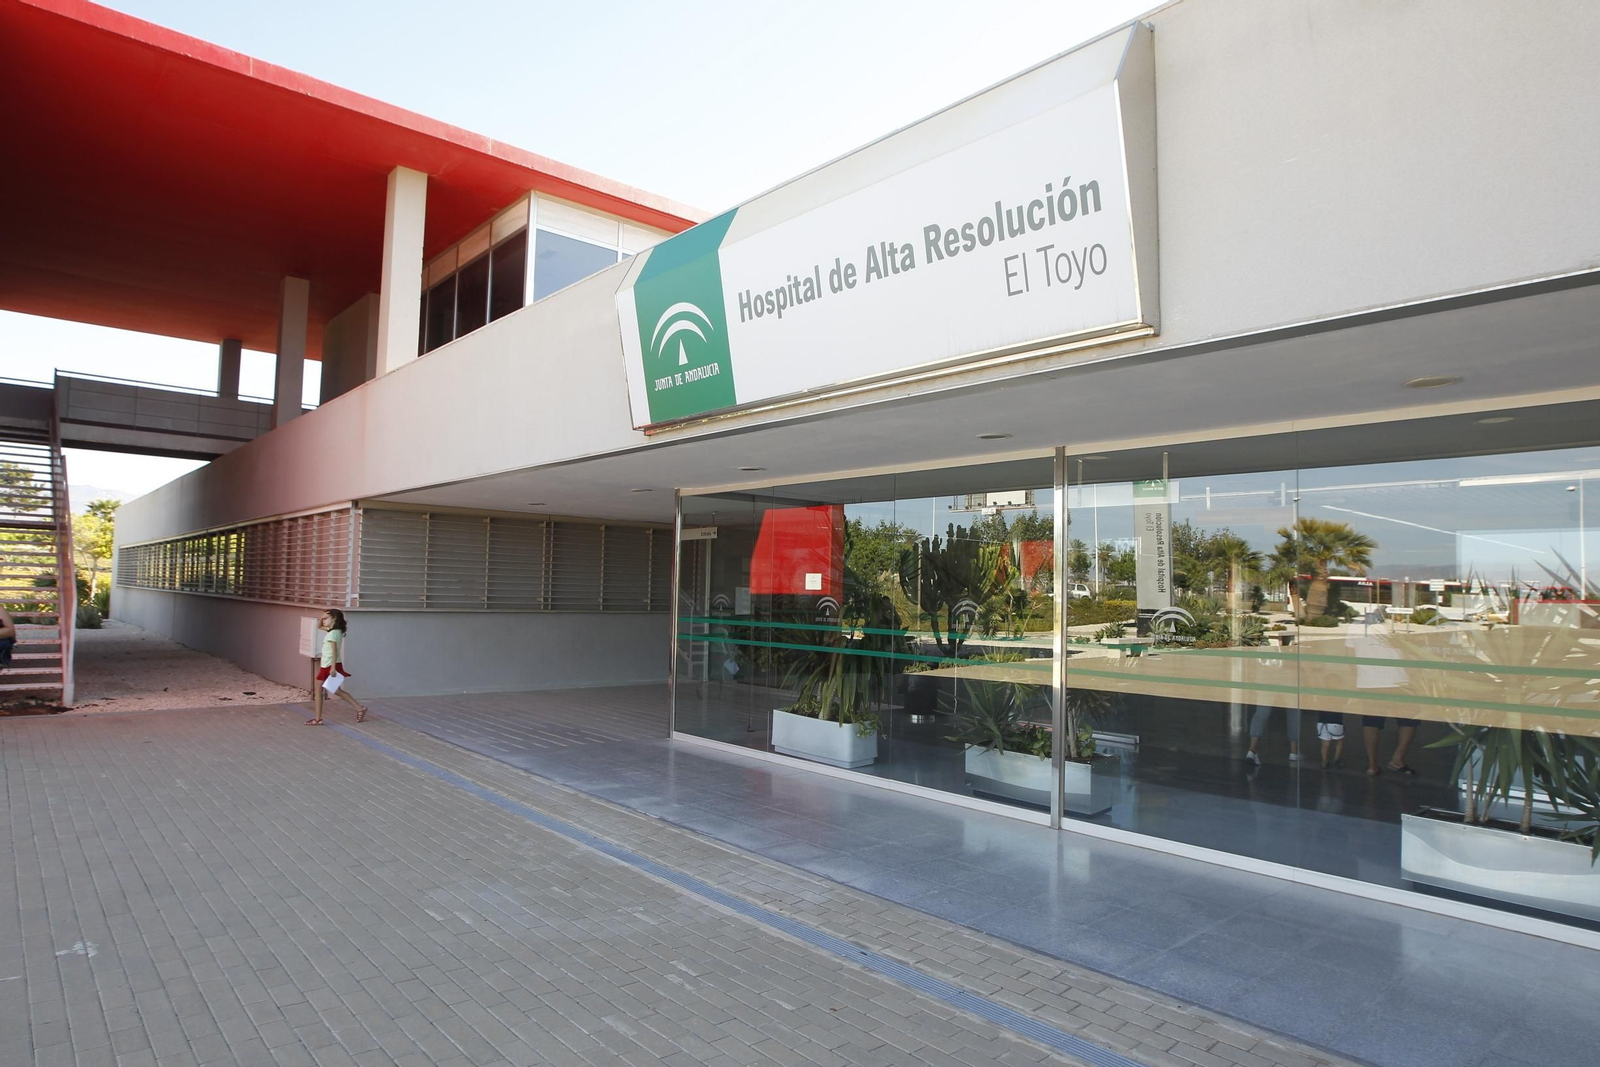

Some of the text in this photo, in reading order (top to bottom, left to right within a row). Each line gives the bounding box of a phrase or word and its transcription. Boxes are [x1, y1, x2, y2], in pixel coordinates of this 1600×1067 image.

[738, 176, 1102, 322] Hospital de Alta Resolución
[1004, 242, 1108, 297] El Toyo
[655, 376, 673, 391] JUNTA
[674, 373, 683, 386] DE
